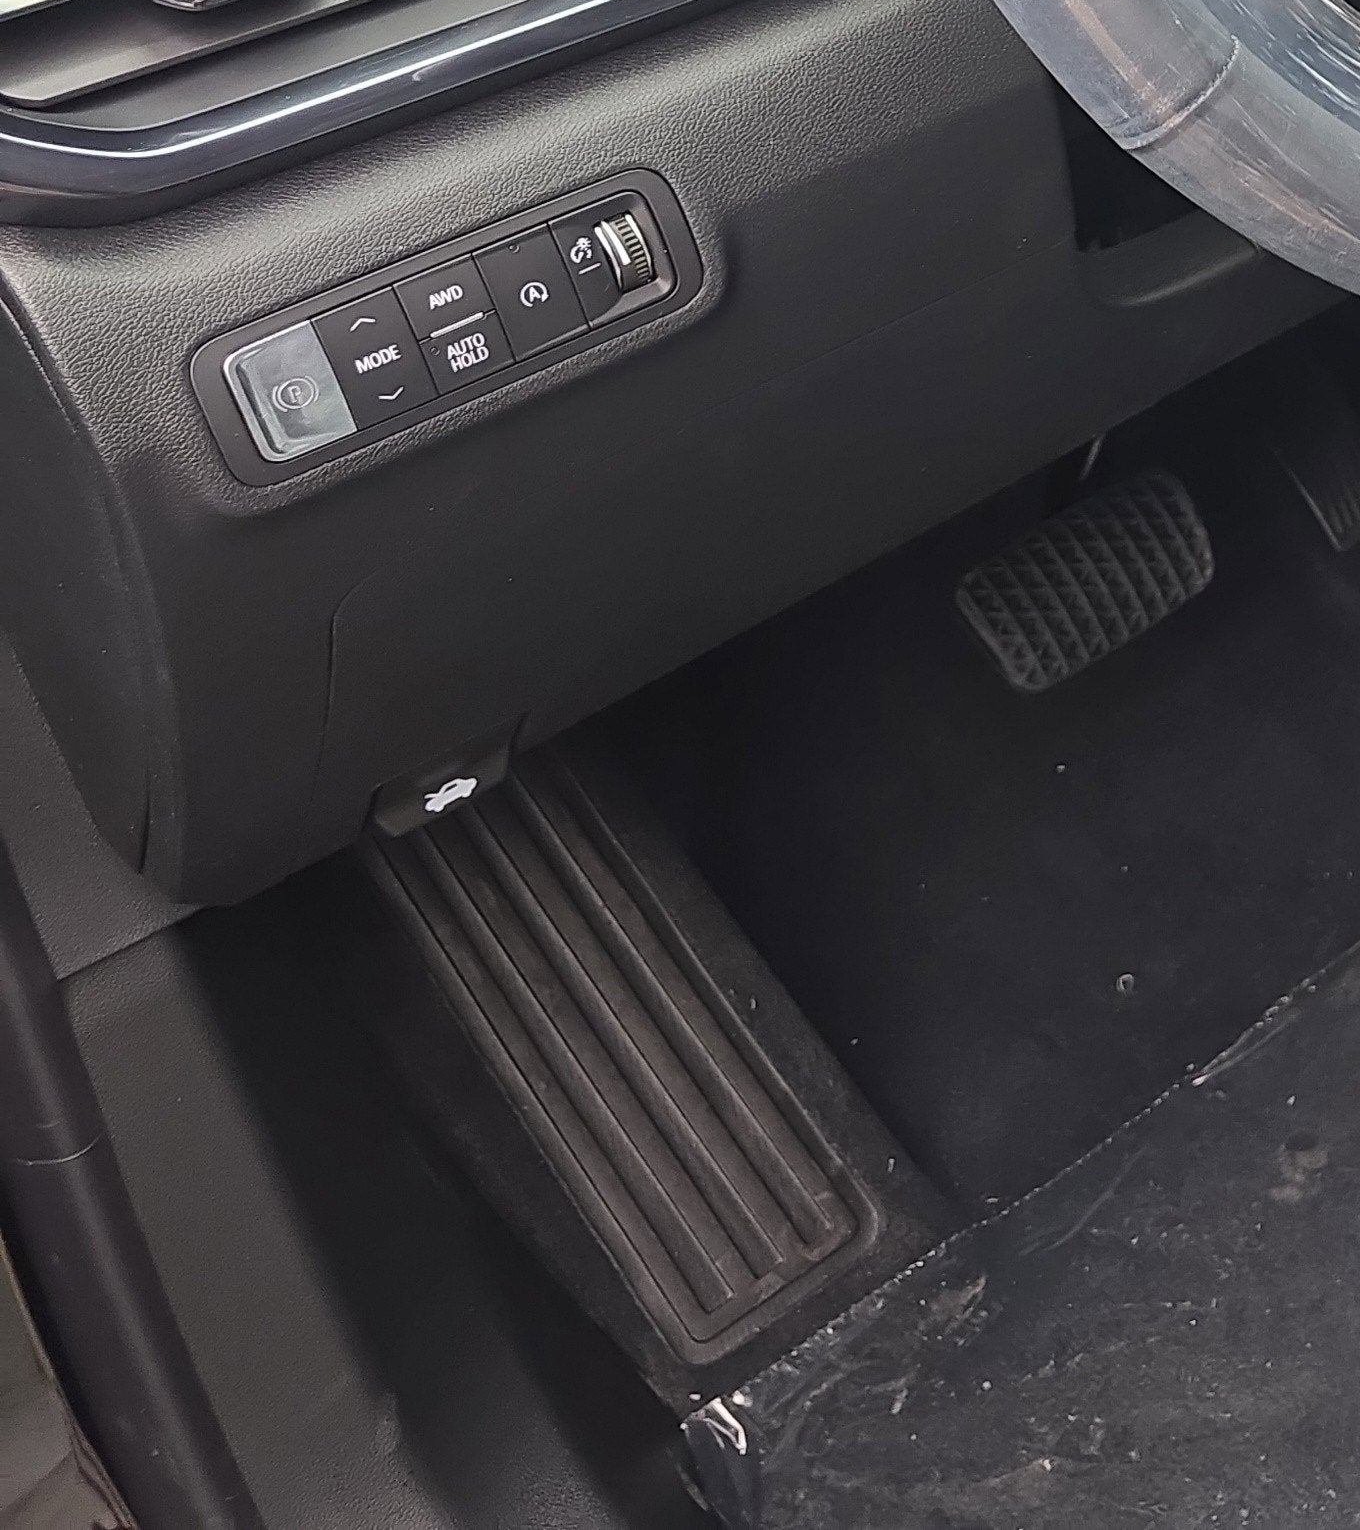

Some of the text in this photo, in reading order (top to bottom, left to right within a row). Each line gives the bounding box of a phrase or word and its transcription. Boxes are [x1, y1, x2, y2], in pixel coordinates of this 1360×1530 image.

[428, 284, 464, 310] AWD
[354, 344, 403, 374] MODE
[446, 332, 486, 360] AUTO
[450, 345, 490, 373] HOLD
